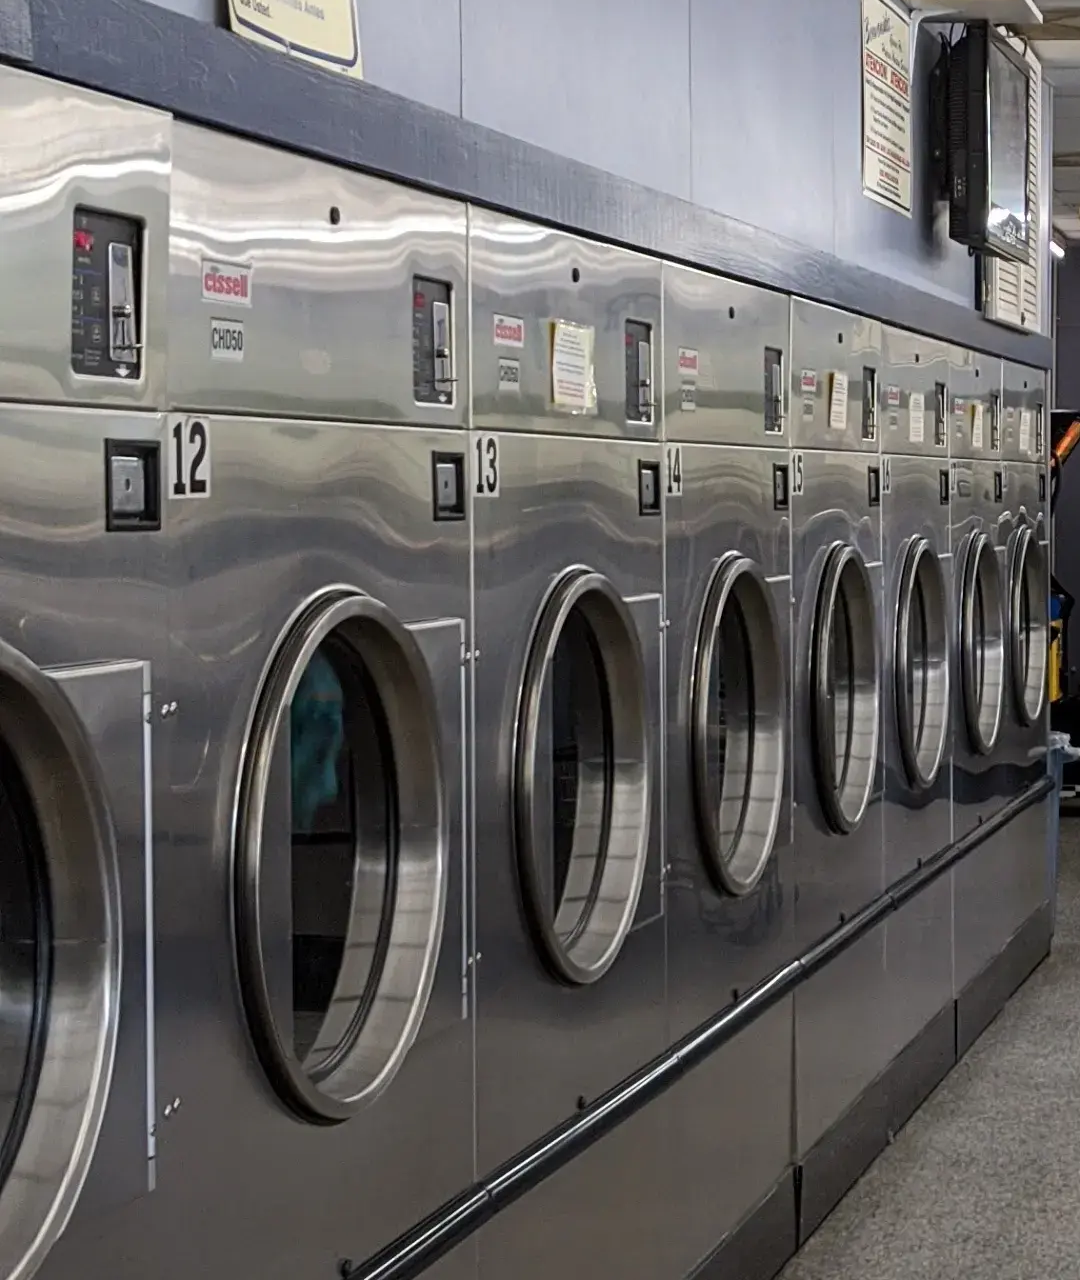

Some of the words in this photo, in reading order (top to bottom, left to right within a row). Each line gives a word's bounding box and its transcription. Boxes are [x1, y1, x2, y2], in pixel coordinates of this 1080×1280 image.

[204, 272, 248, 298] cissell
[212, 327, 243, 351] CHD50
[173, 421, 206, 495] 12
[476, 437, 498, 493] 13
[667, 448, 681, 493] 14
